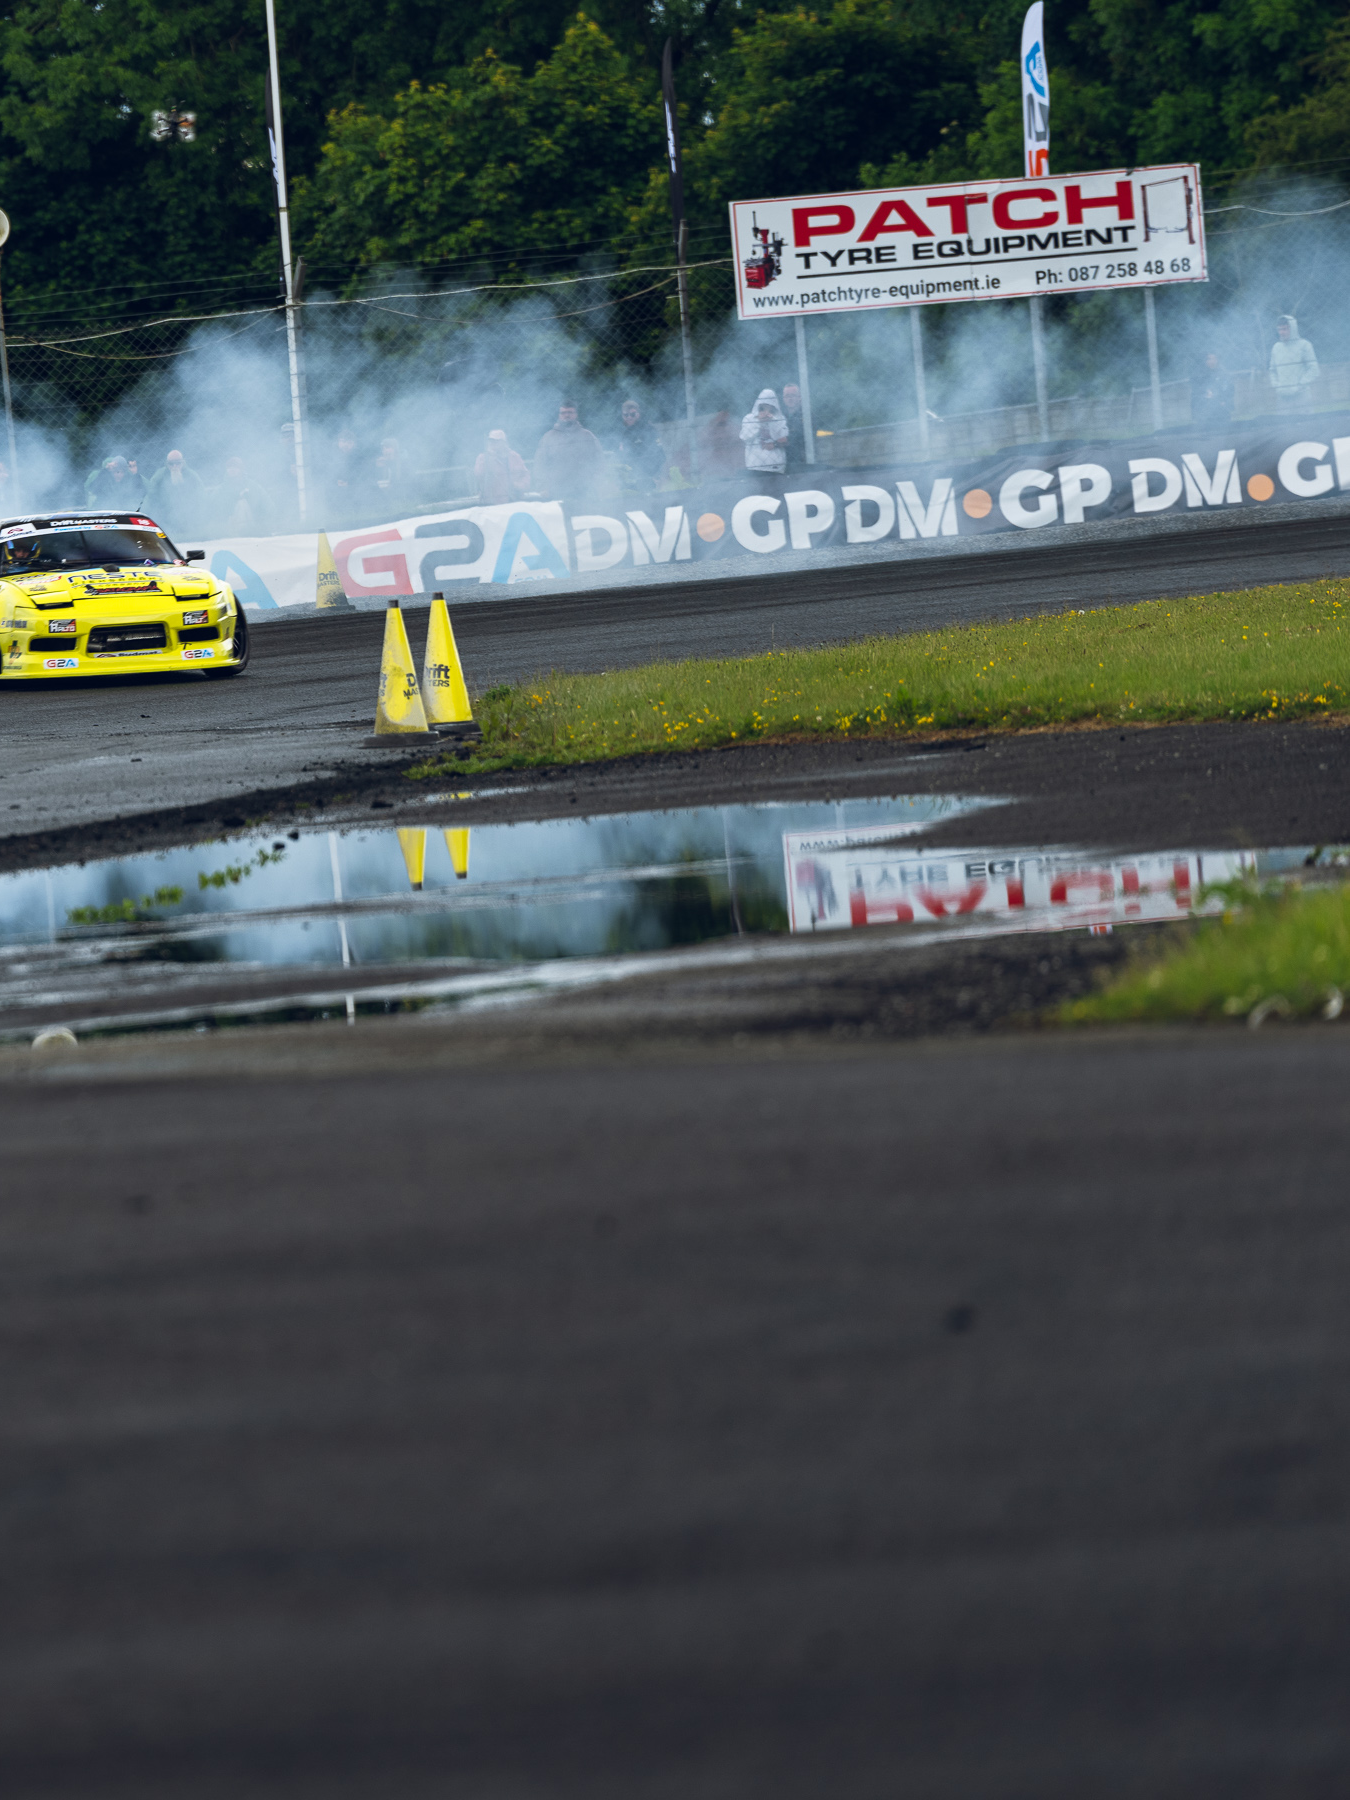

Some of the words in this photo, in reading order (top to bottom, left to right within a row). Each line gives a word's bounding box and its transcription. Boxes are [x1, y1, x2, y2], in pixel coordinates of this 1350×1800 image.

[791, 180, 1136, 248] PATCH
[795, 245, 898, 270] TYRE
[912, 225, 1136, 261] EQUIPMENT
[1036, 269, 1063, 286] Ph:
[1067, 266, 1101, 284] 087
[1105, 262, 1138, 280] 258
[1143, 260, 1164, 277] 48
[1169, 257, 1191, 273] 68
[753, 275, 1001, 309] www.patchtyre-equipment.ie
[333, 511, 570, 598] G2A
[47, 658, 76, 668] G2A
[184, 648, 213, 659] G2A
